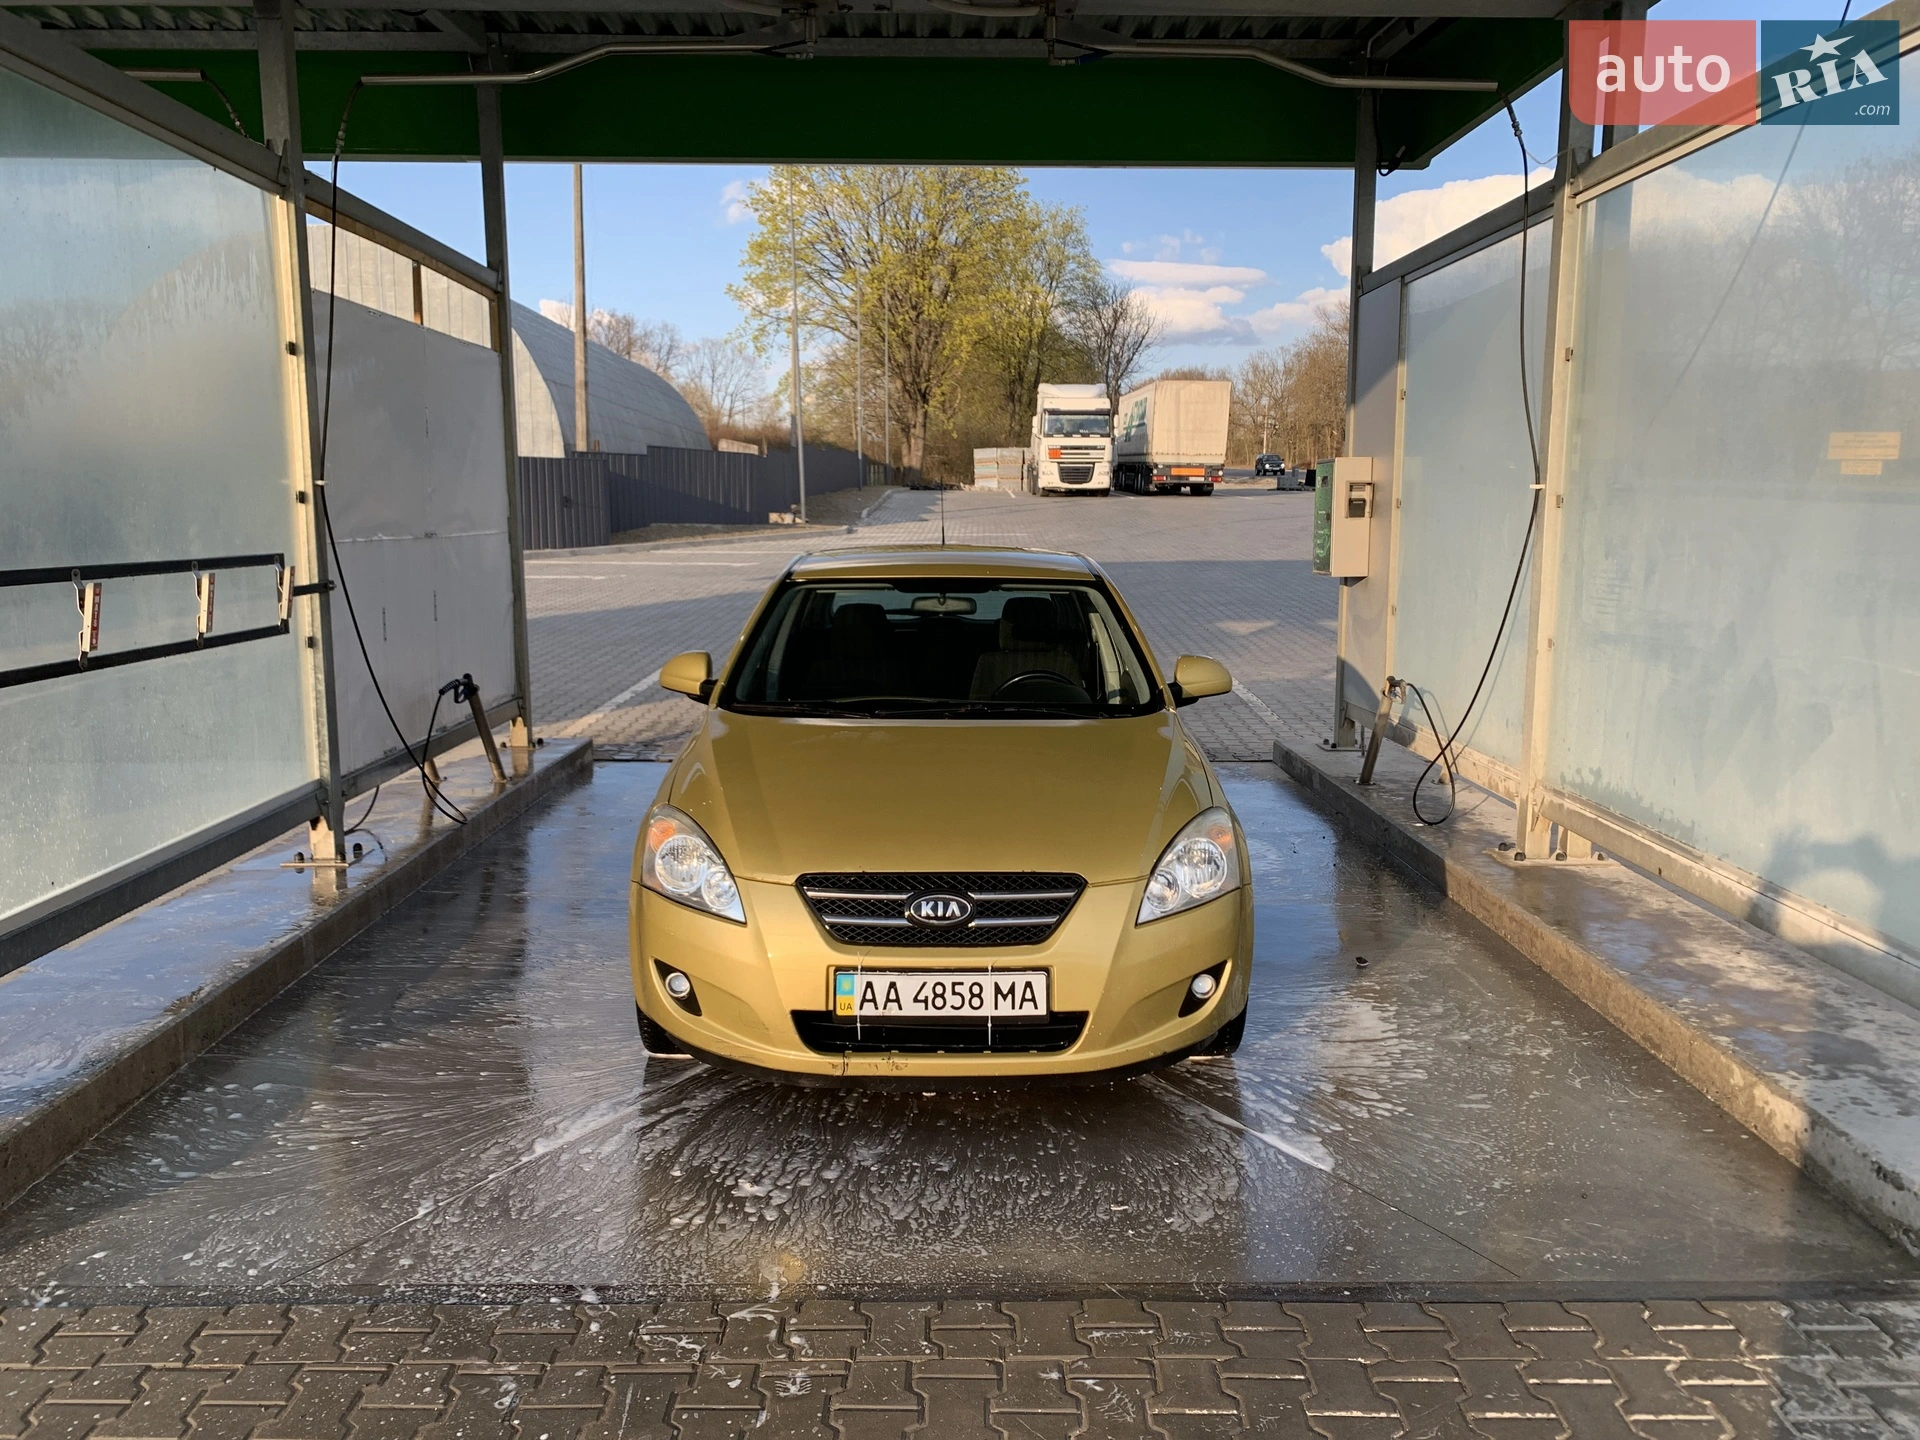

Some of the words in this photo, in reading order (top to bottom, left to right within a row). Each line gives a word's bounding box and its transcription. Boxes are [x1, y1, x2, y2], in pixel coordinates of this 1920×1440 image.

[920, 901, 961, 917] KIA
[859, 981, 903, 1011] AA
[912, 981, 985, 1011] 4858
[994, 981, 1039, 1011] MA
[839, 1003, 853, 1011] UA
